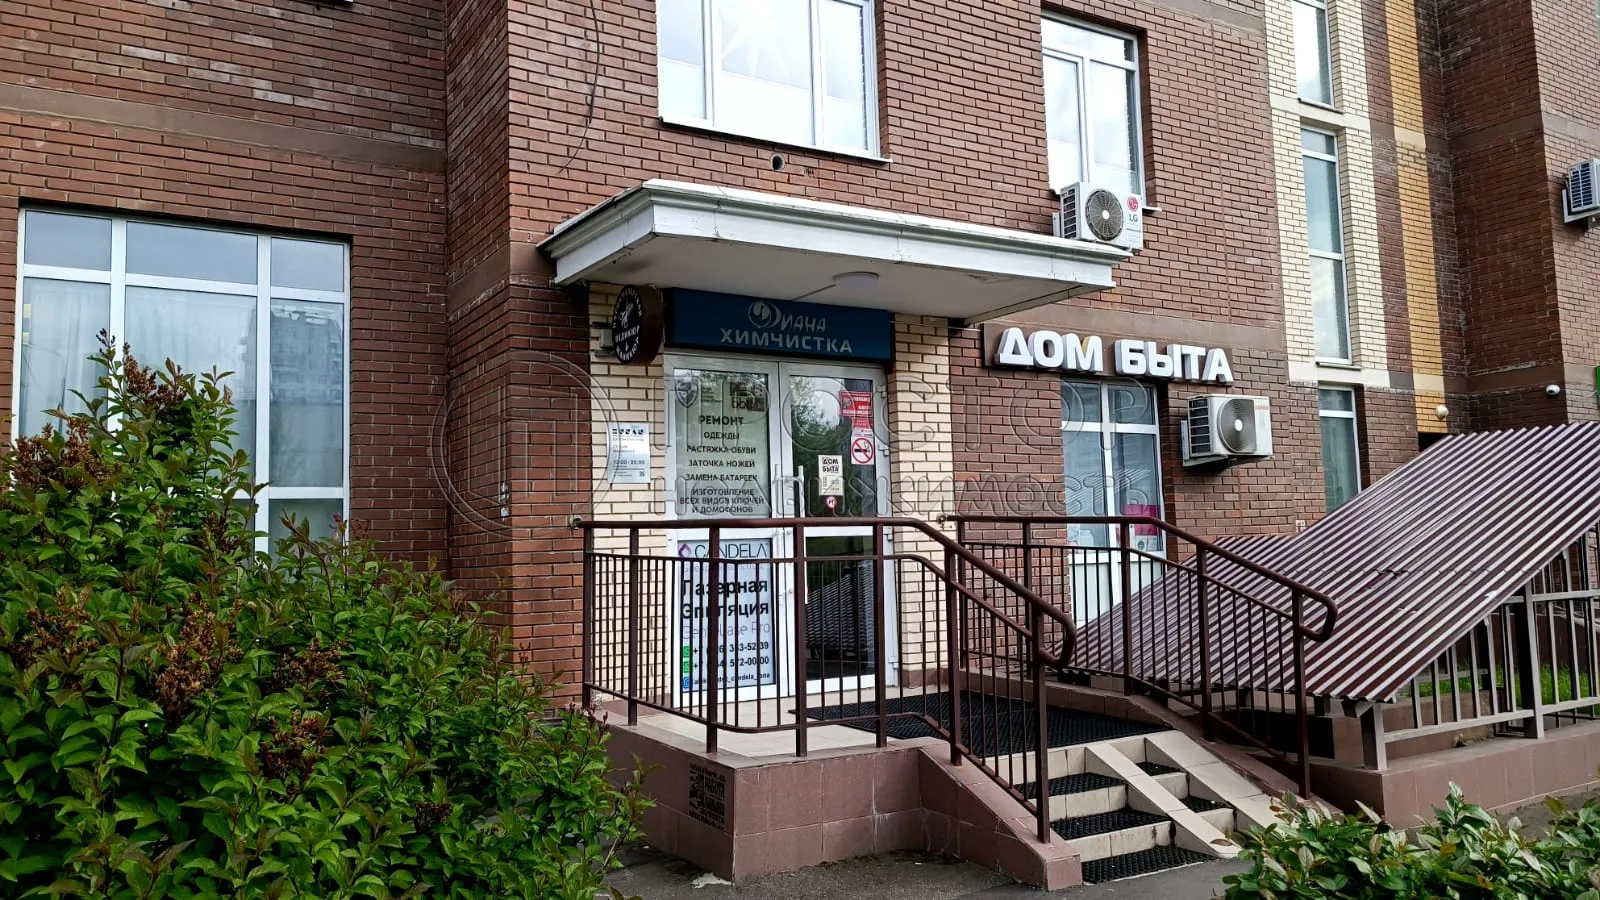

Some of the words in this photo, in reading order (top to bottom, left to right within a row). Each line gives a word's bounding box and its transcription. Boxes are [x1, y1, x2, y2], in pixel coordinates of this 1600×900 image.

[1128, 213, 1138, 222] LG
[720, 328, 853, 353] ХИМЧИСТКА
[996, 327, 1103, 372] ДОМ
[1114, 338, 1233, 383] БЫТА
[699, 415, 744, 425] РЕМОНТ
[703, 431, 739, 440] ОДЕЖДЫ
[687, 445, 729, 453] РАСТЯЖКА
[731, 446, 756, 454] ОБУВИ
[689, 459, 724, 467] ЗАТОЧКА
[726, 459, 755, 467] НОЖЕЙ
[822, 465, 839, 473] БЫТА
[692, 488, 755, 496] ИЗГОТОВЛЕНИЕ
[732, 496, 764, 505] КЛЮЧЕЙ
[700, 505, 753, 513] ДОМОФОНОВ
[694, 543, 768, 559] CNDELA
